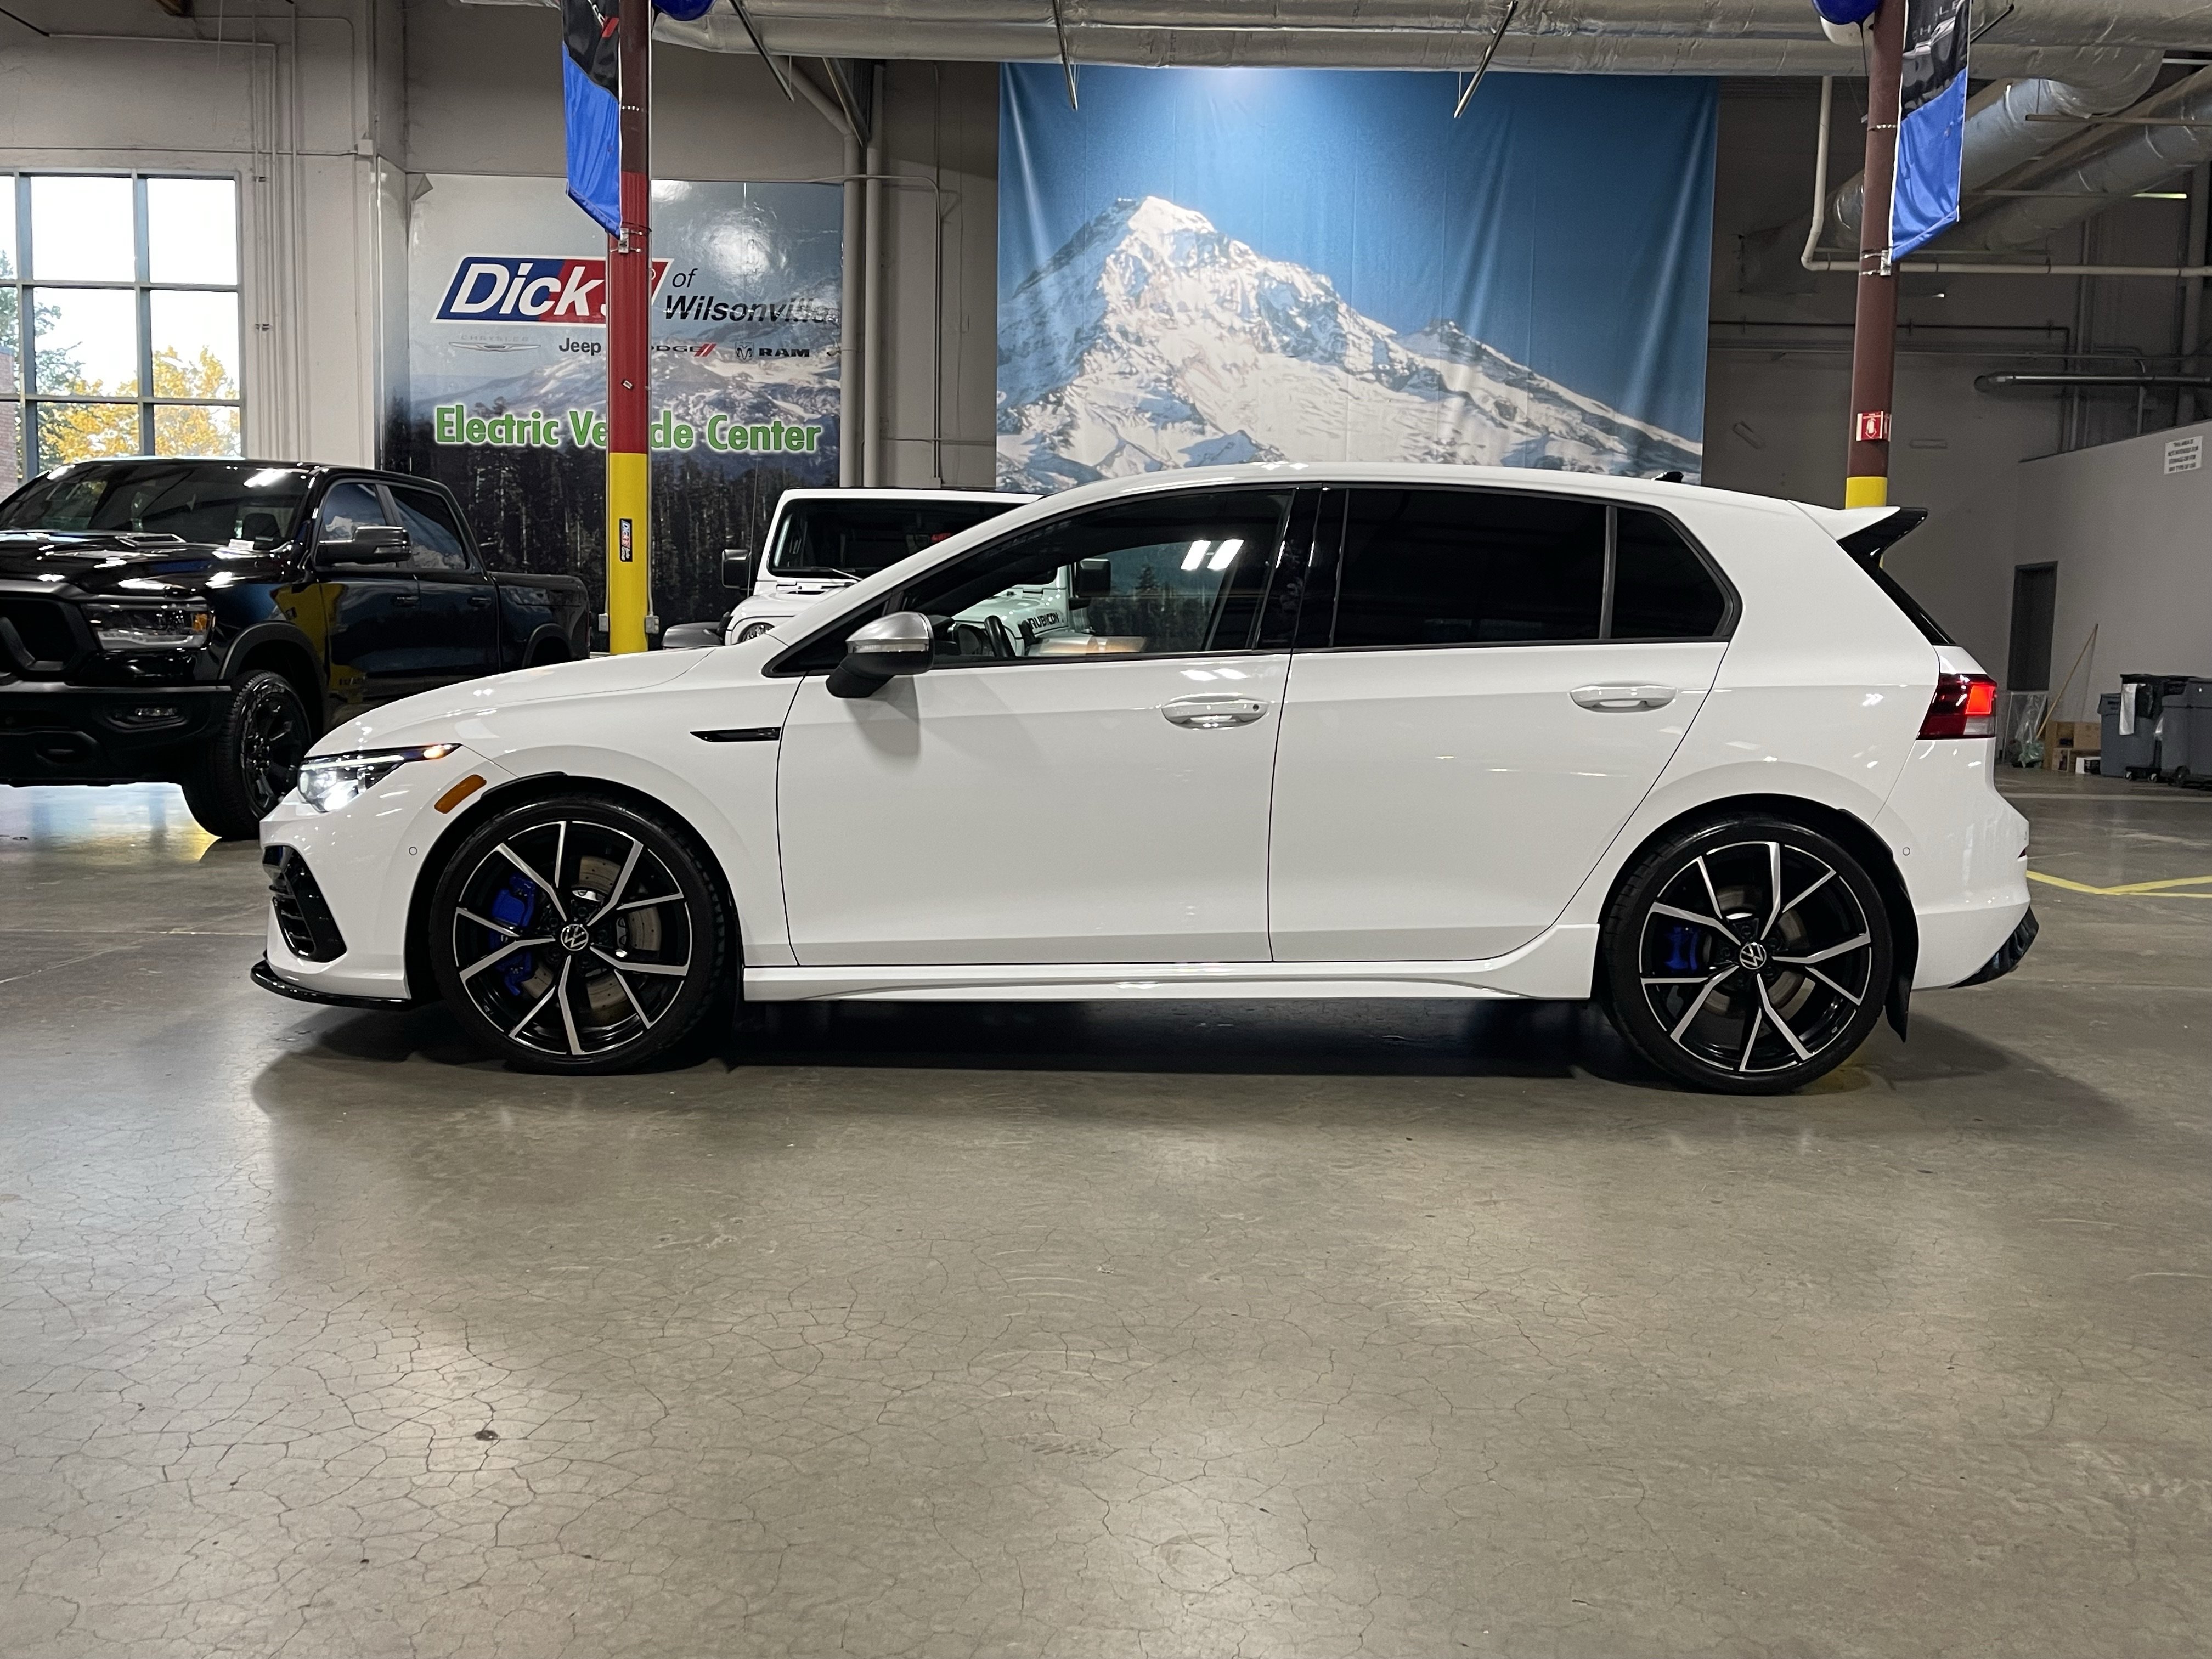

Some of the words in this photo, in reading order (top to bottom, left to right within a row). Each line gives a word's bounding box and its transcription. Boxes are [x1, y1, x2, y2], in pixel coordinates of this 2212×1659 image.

[672, 268, 698, 288] of
[558, 338, 601, 356] Jeep
[651, 345, 703, 353] DGE
[759, 348, 810, 357] RAM
[437, 405, 559, 445] Electric
[569, 410, 693, 448] Vecle
[708, 415, 821, 451] Center
[1026, 612, 1060, 630] RUBICON
